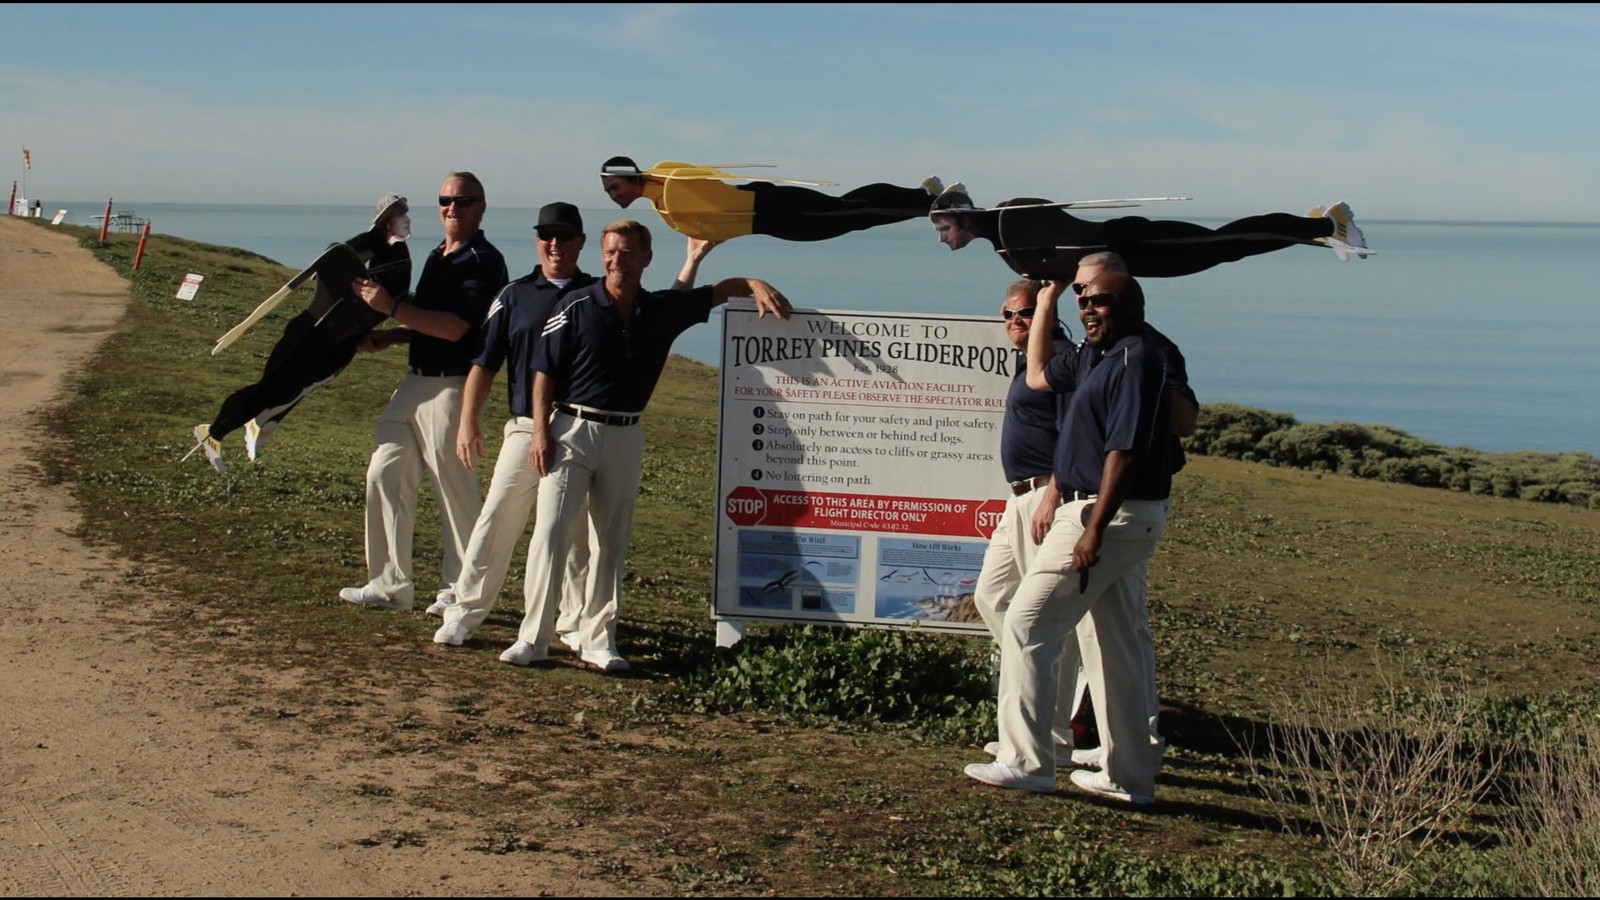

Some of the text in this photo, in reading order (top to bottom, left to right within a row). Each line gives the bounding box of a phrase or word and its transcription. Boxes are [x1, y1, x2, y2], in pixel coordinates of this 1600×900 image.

[807, 320, 948, 340] WELCOME TO
[732, 336, 1023, 377] TORREY PINES GLIDERPORT
[876, 364, 898, 374] 1928
[775, 376, 977, 394] THIS IS AN ACTIVE AVIATION FACILITY.
[734, 386, 1008, 408] FOR YOUR SAFETY PLEASE OBSERVE THE SPECTATOR RUL
[767, 409, 790, 422] Stay
[792, 412, 806, 420] on
[808, 411, 832, 423] path
[835, 411, 851, 422] for
[853, 415, 876, 426] your
[880, 414, 910, 428] safety
[912, 416, 932, 426] and
[936, 417, 960, 430] pilot
[963, 418, 998, 432] safety.
[767, 425, 792, 437] Stop
[794, 426, 816, 438] only
[820, 426, 864, 438] between
[866, 431, 878, 439] or
[880, 430, 917, 441] behind
[920, 432, 937, 442] red
[940, 432, 964, 446] logs.
[766, 440, 822, 454] Absolutely
[840, 447, 872, 455] access
[875, 448, 886, 456] to
[888, 446, 915, 457] cliffs
[917, 450, 928, 458] or
[930, 451, 964, 462] grassy
[766, 454, 860, 469] beyond this point.
[766, 470, 782, 480] No
[784, 471, 828, 484] loitering
[830, 476, 844, 484] on
[846, 475, 874, 486] path.
[728, 498, 764, 514] STOP
[773, 494, 968, 514] ACCESS TO THIS AREA BY PERMISSION OF
[814, 508, 927, 522] FLIGHT DIRECTOR ONLY
[831, 520, 862, 529] Municipal
